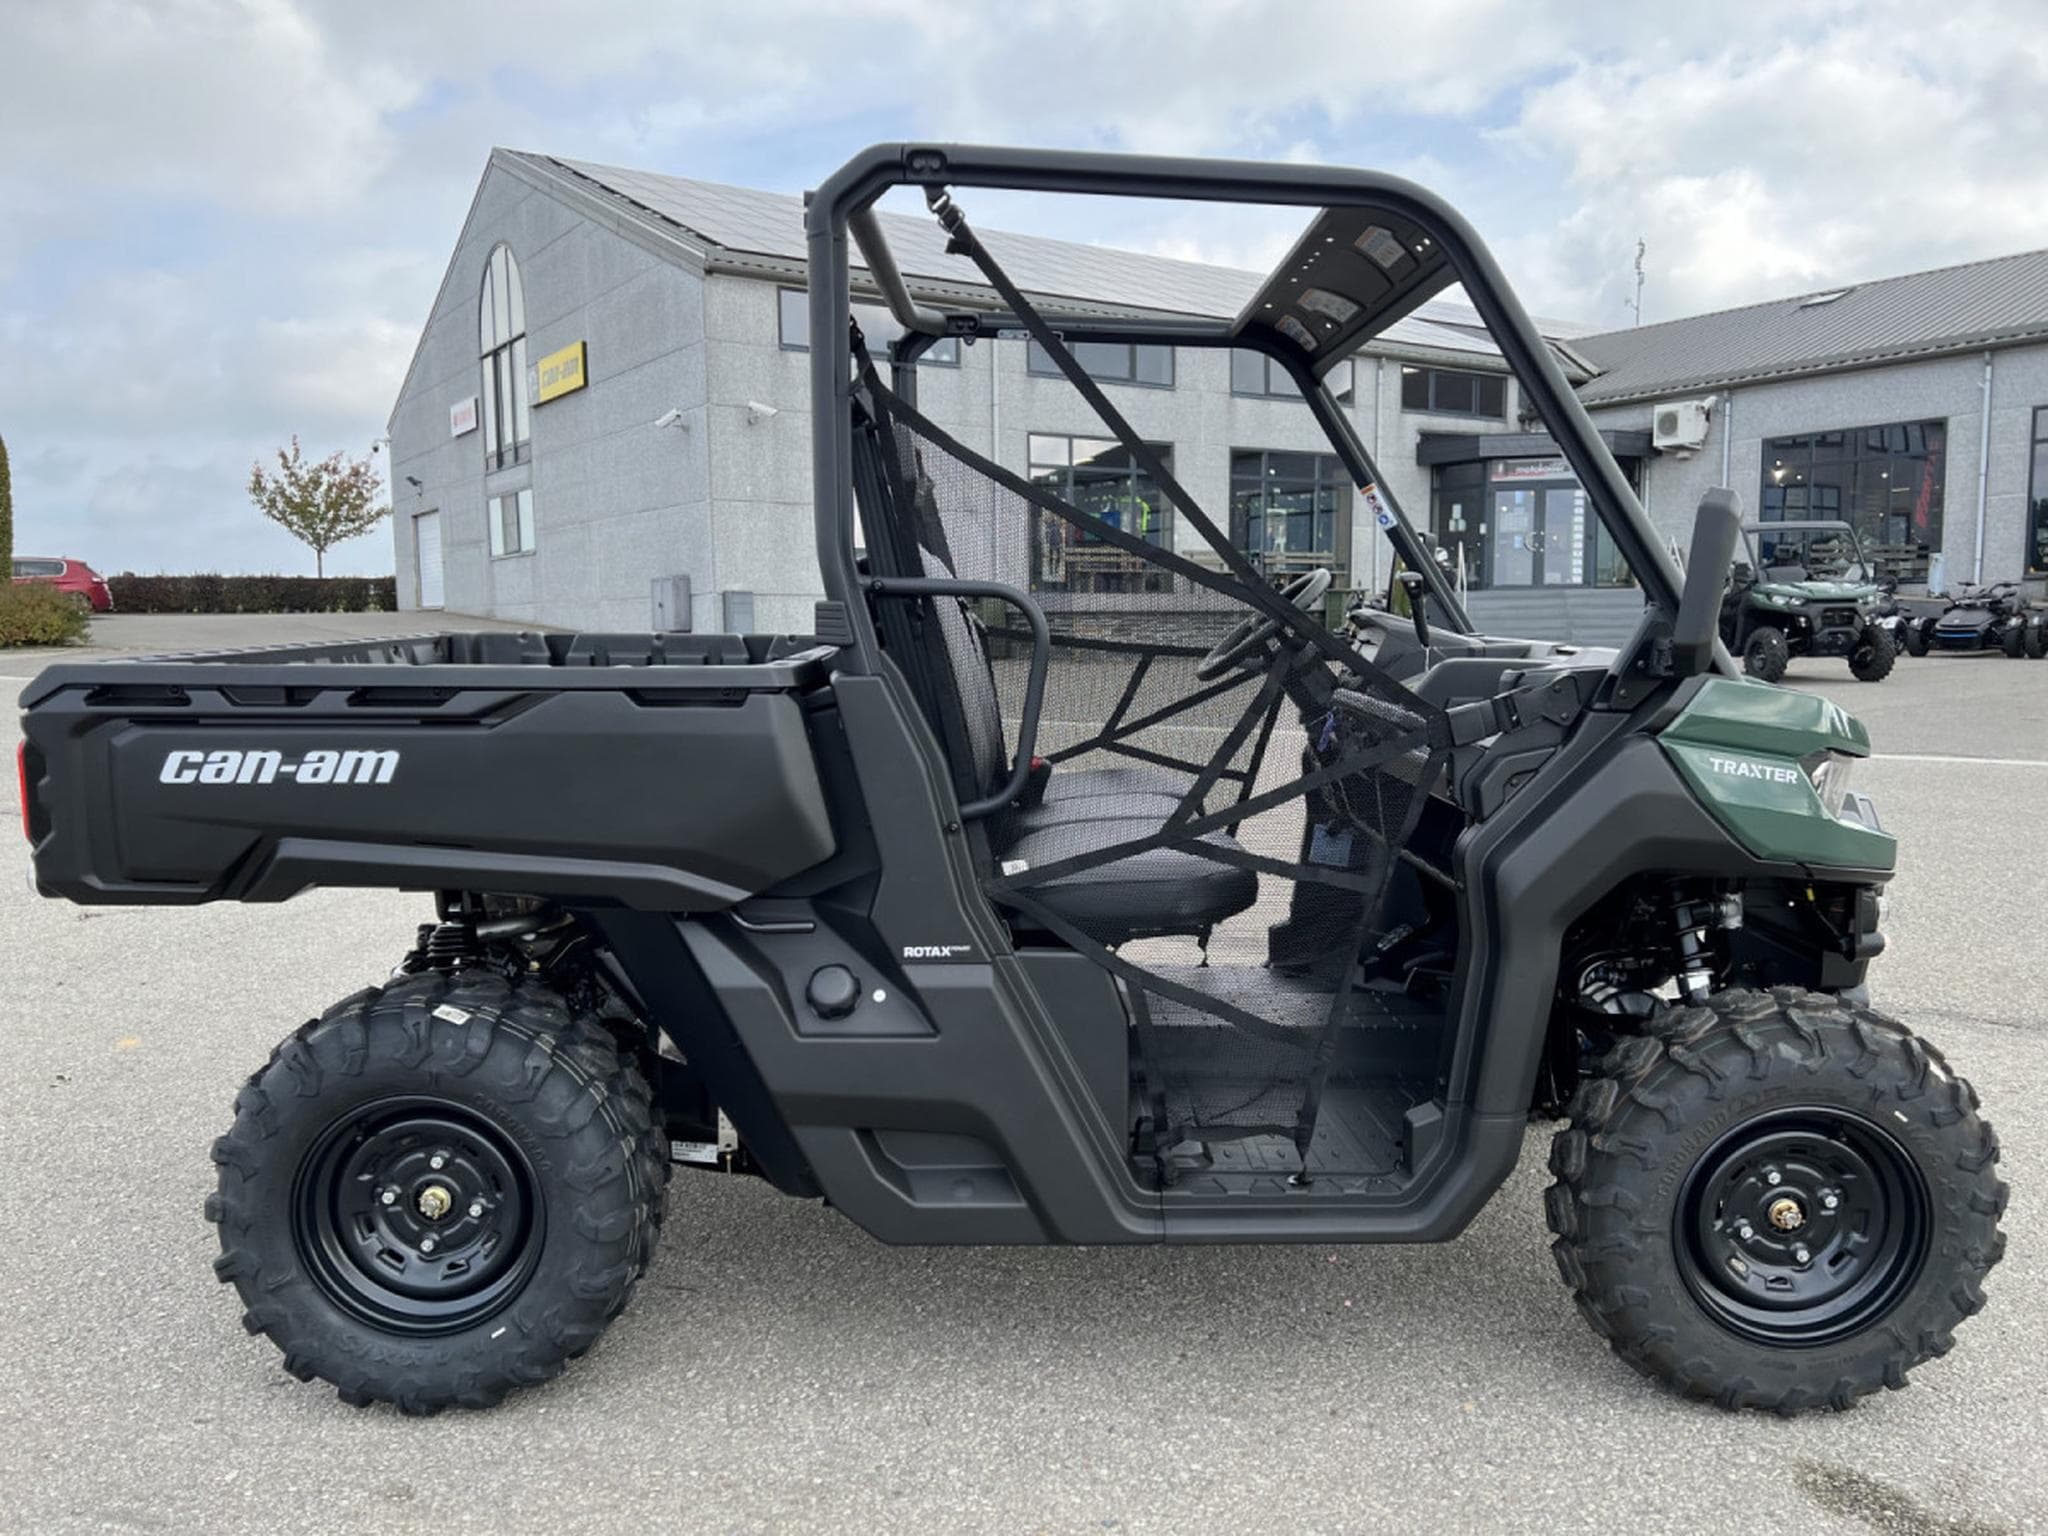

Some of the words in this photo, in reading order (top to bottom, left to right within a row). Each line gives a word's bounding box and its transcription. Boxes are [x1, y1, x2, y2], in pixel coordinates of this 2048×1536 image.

[159, 749, 400, 784] can-am
[1708, 757, 1798, 784] TRAXTER
[903, 946, 951, 958] ROTAX
